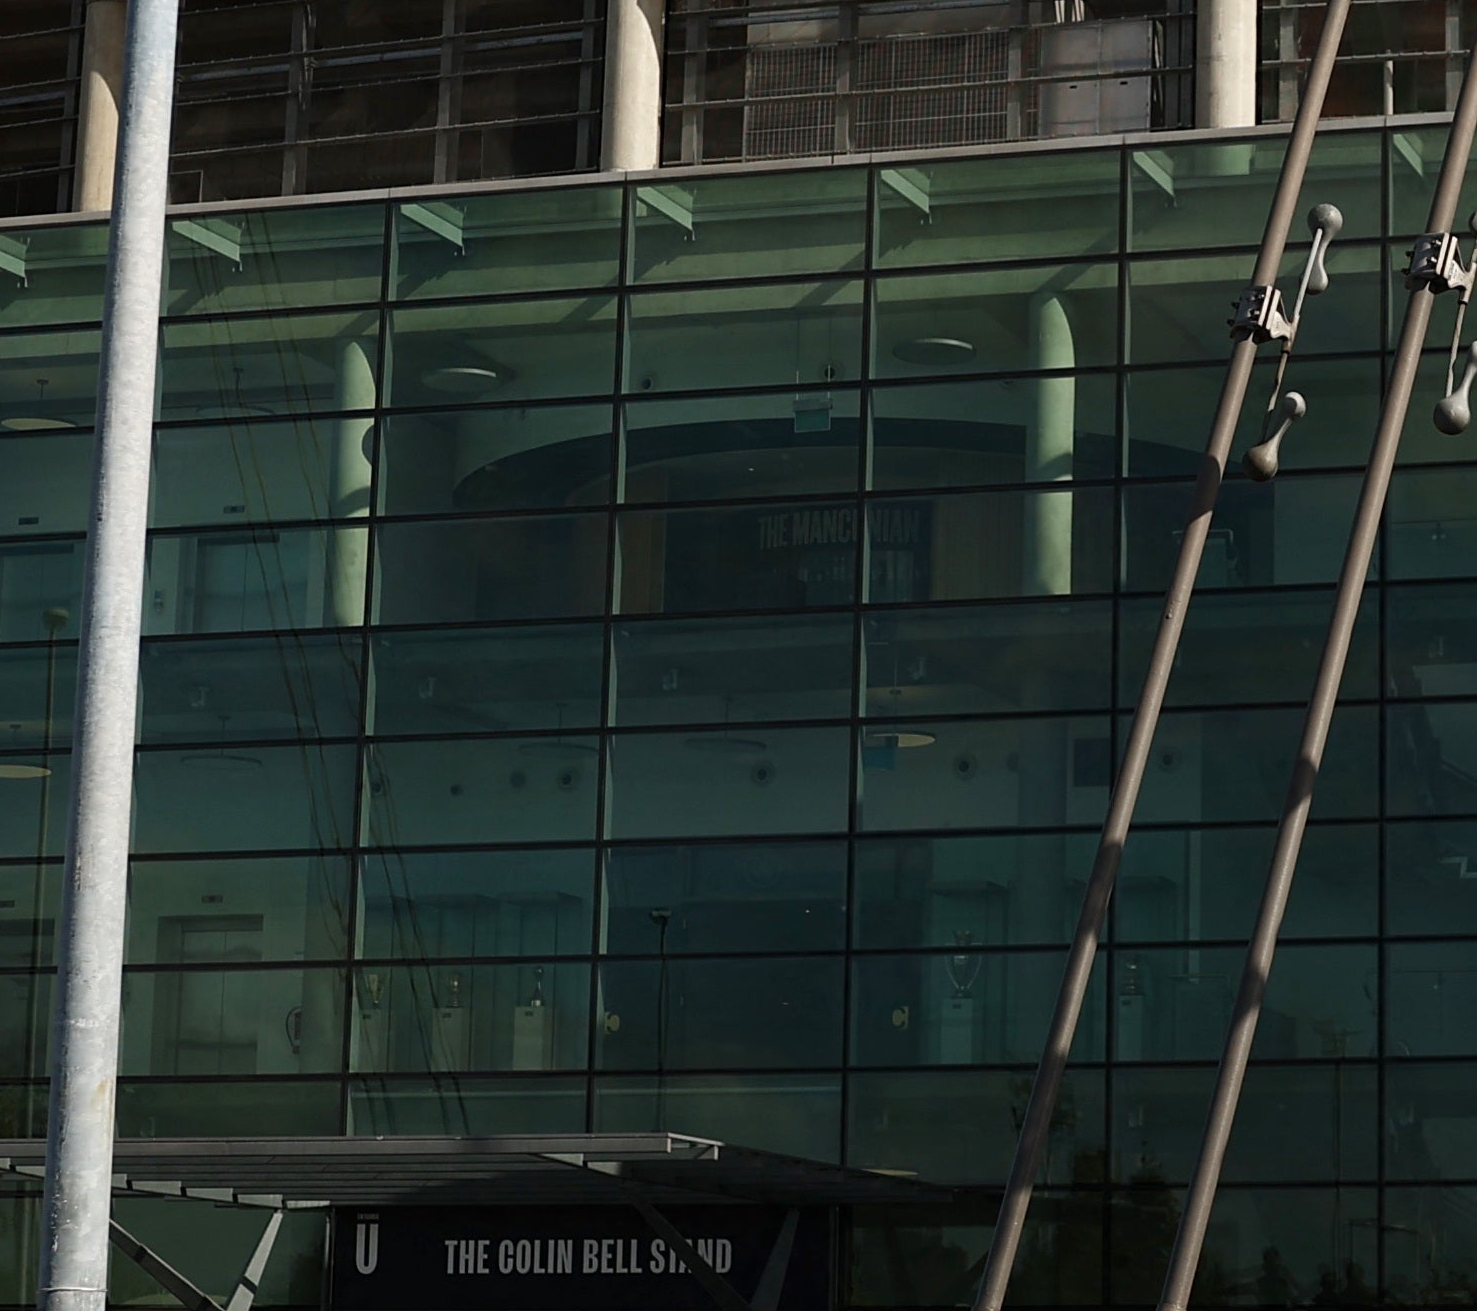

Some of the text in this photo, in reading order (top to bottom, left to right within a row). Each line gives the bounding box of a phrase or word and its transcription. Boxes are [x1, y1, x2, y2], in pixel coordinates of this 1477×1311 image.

[758, 512, 788, 549] THE
[356, 1223, 379, 1274] U
[445, 1238, 642, 1275] THE COLIN BELL
